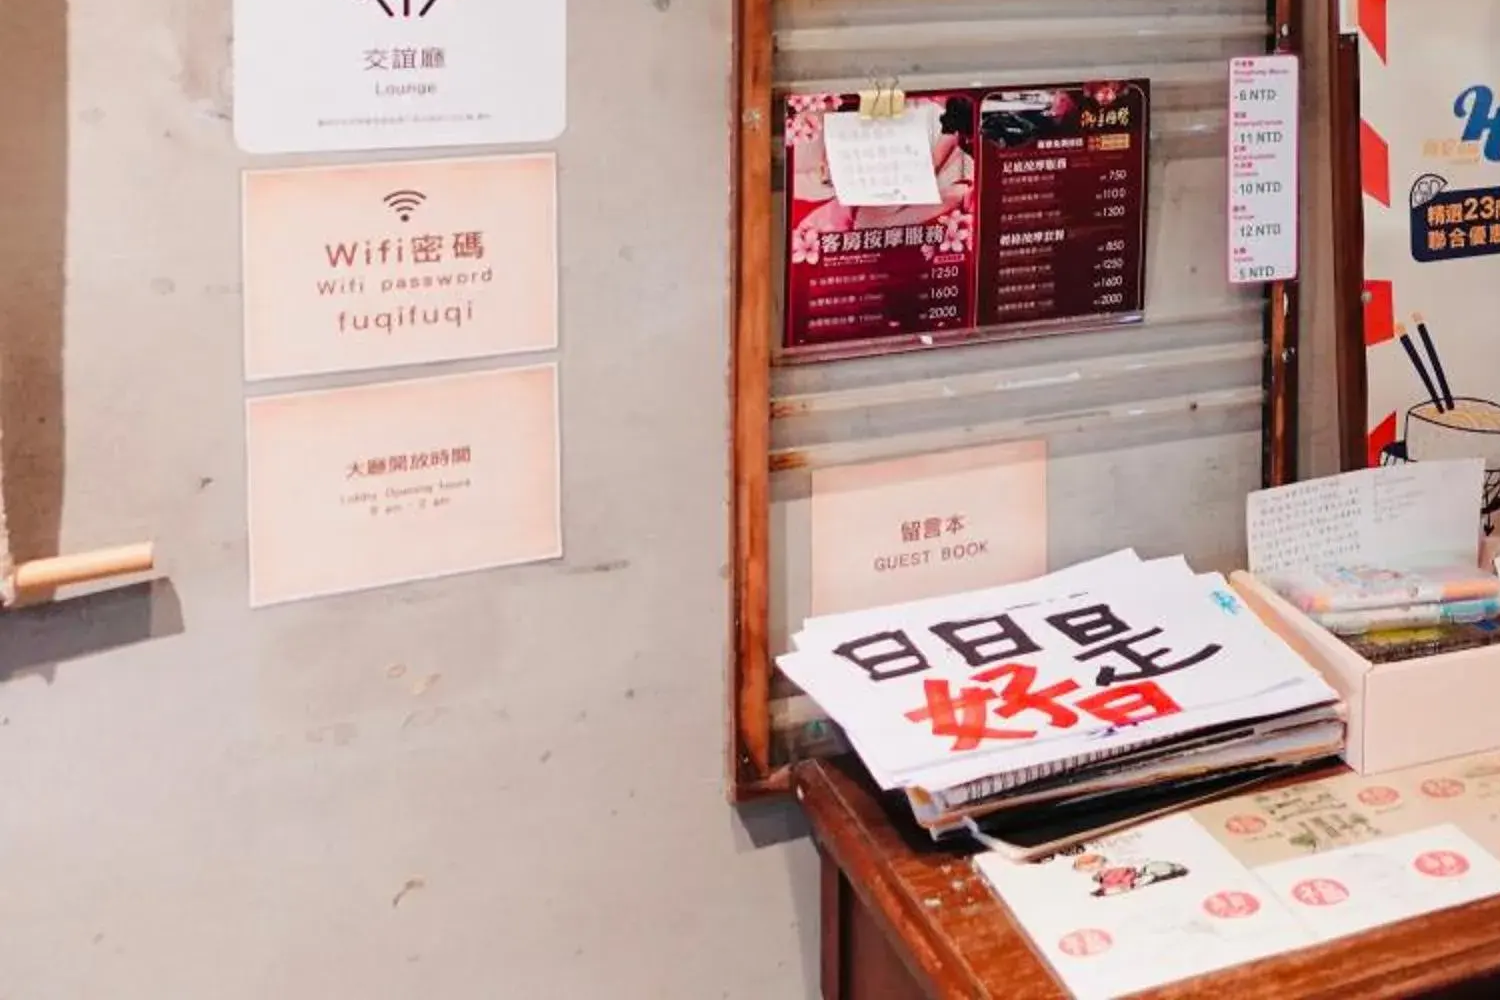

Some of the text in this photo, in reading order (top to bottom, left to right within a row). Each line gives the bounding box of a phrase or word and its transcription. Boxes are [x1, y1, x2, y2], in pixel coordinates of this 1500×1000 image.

[362, 47, 446, 71] 交誼廳
[375, 81, 437, 98] Lounge
[1249, 88, 1277, 101] NTD
[1256, 131, 1283, 143] NTD
[1256, 181, 1283, 194] NTD
[822, 225, 945, 253] 客房按摩服務
[1256, 223, 1281, 237] NTD
[325, 231, 485, 268] Wifi密碼
[317, 267, 494, 296] Wifi password
[1249, 265, 1276, 278] NTD
[931, 286, 959, 299] 1600
[338, 301, 473, 335] fuqifuqi
[928, 306, 957, 319] 2000
[901, 514, 967, 542] 留言本
[874, 541, 989, 572] GUEST BOOK
[832, 603, 1223, 688] 日日是
[903, 662, 1185, 751] 好日
